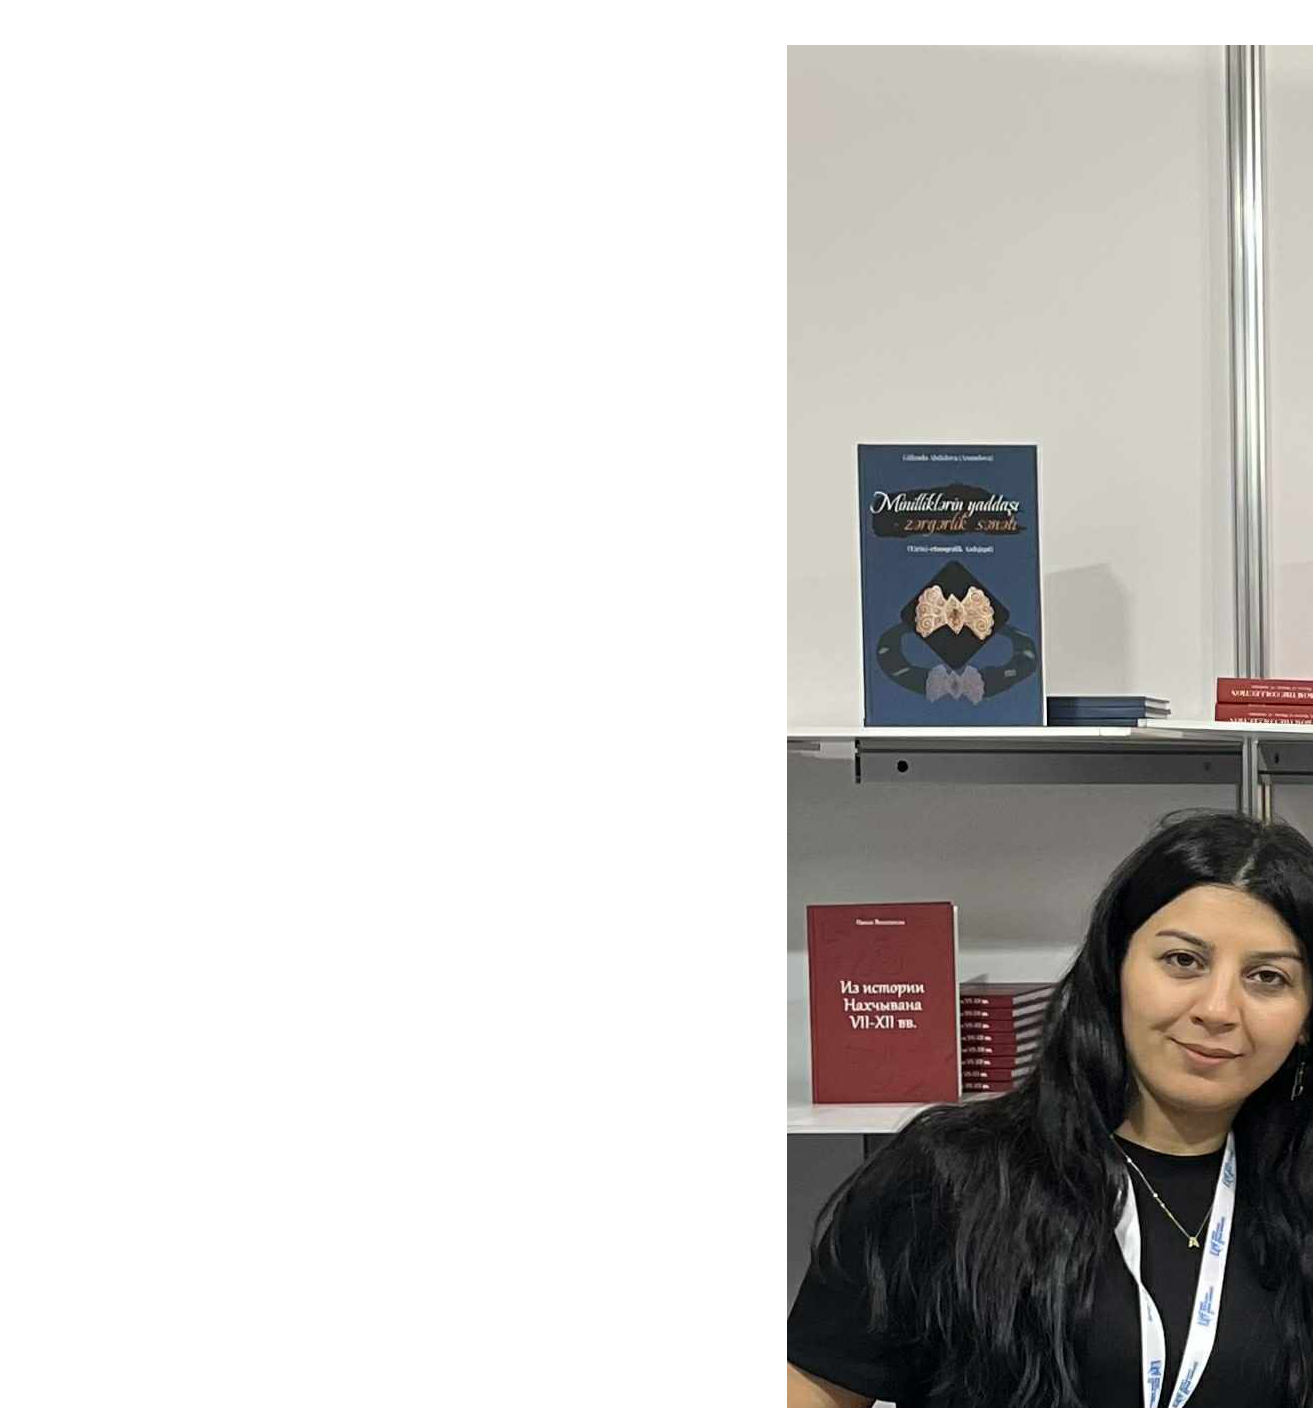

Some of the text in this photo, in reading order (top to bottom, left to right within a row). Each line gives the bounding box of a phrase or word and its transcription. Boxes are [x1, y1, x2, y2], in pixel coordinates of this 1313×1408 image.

[968, 493, 1020, 517] yaddaşı
[840, 981, 925, 998] Из истории
[843, 999, 923, 1012] Нахчывана
[849, 1015, 917, 1029] VII-XII вв.
